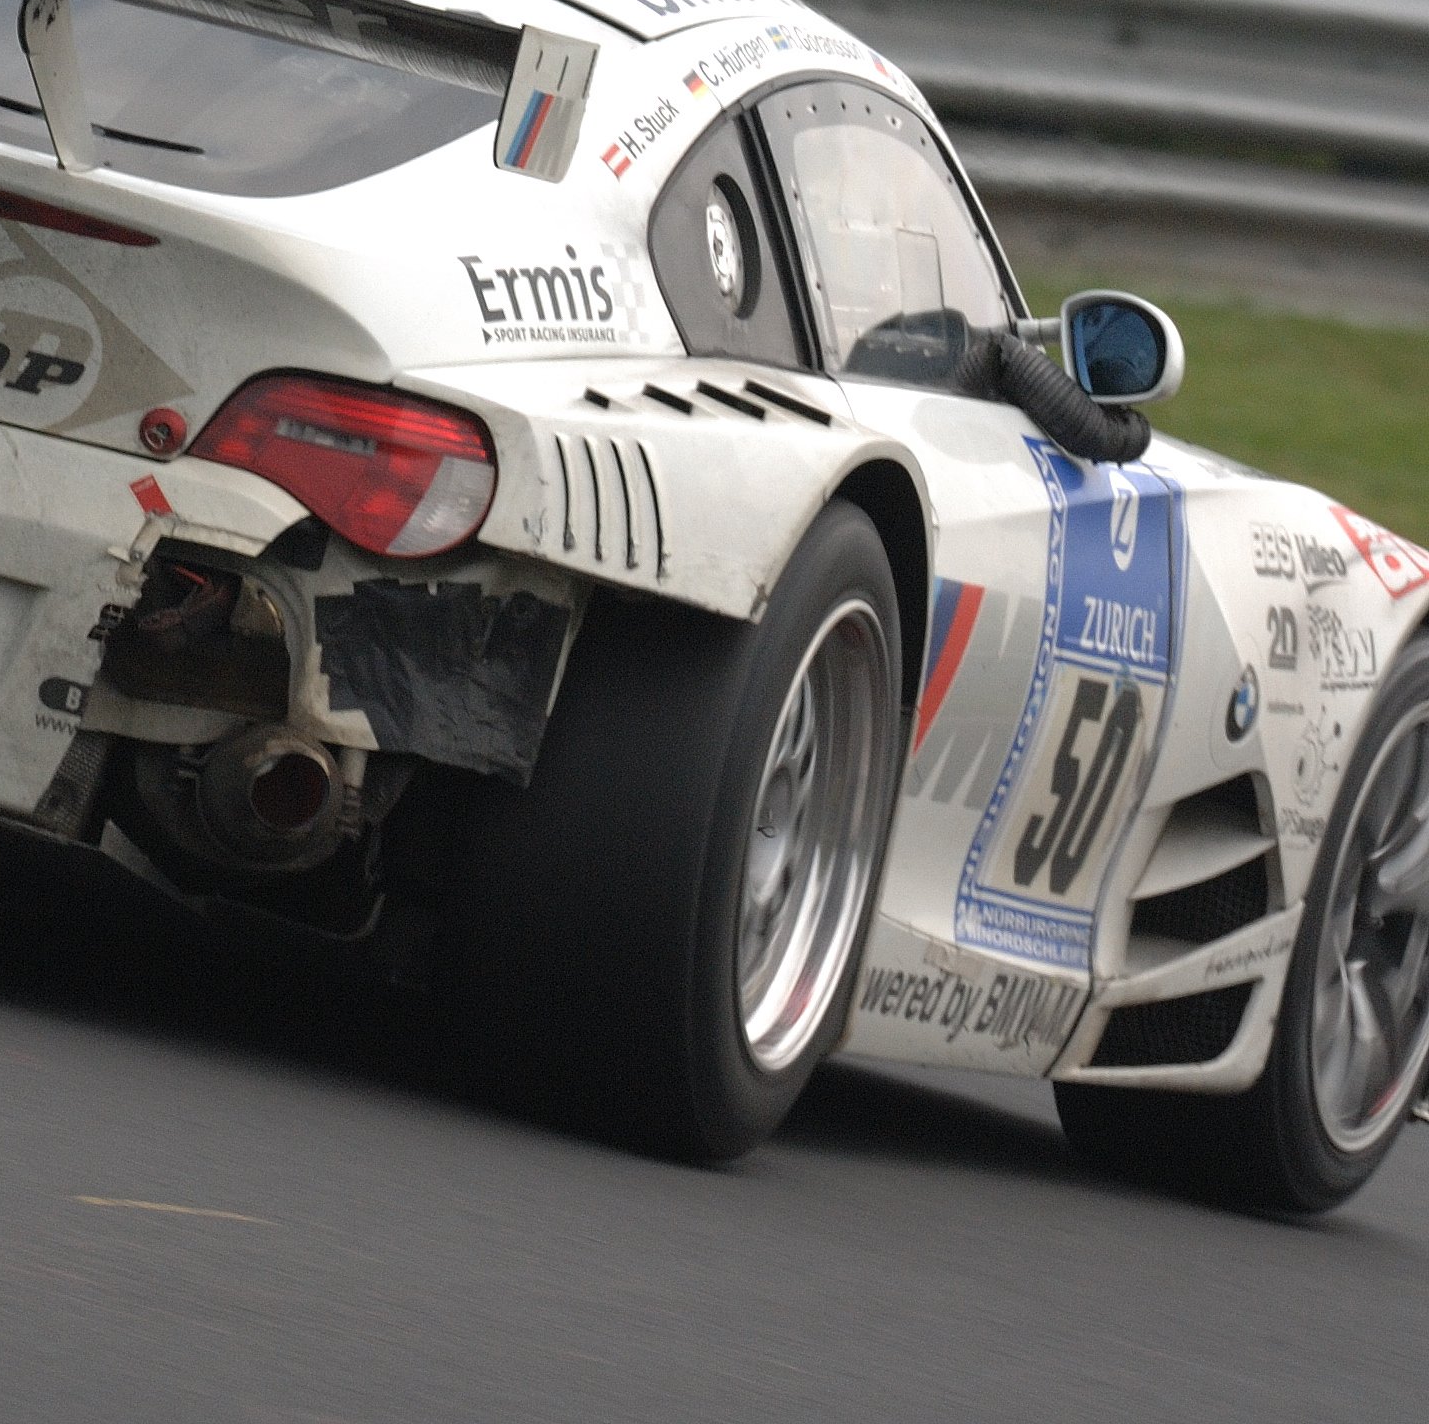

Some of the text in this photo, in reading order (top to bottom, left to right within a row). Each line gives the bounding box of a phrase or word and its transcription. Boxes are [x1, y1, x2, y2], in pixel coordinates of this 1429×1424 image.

[633, 96, 681, 143] Stuck
[457, 244, 613, 324] Ermis
[494, 327, 616, 343] SPORT RACING INSURANCE
[1248, 520, 1296, 581] BBS
[1079, 595, 1157, 664] ZURICH
[1013, 678, 1141, 896] 50
